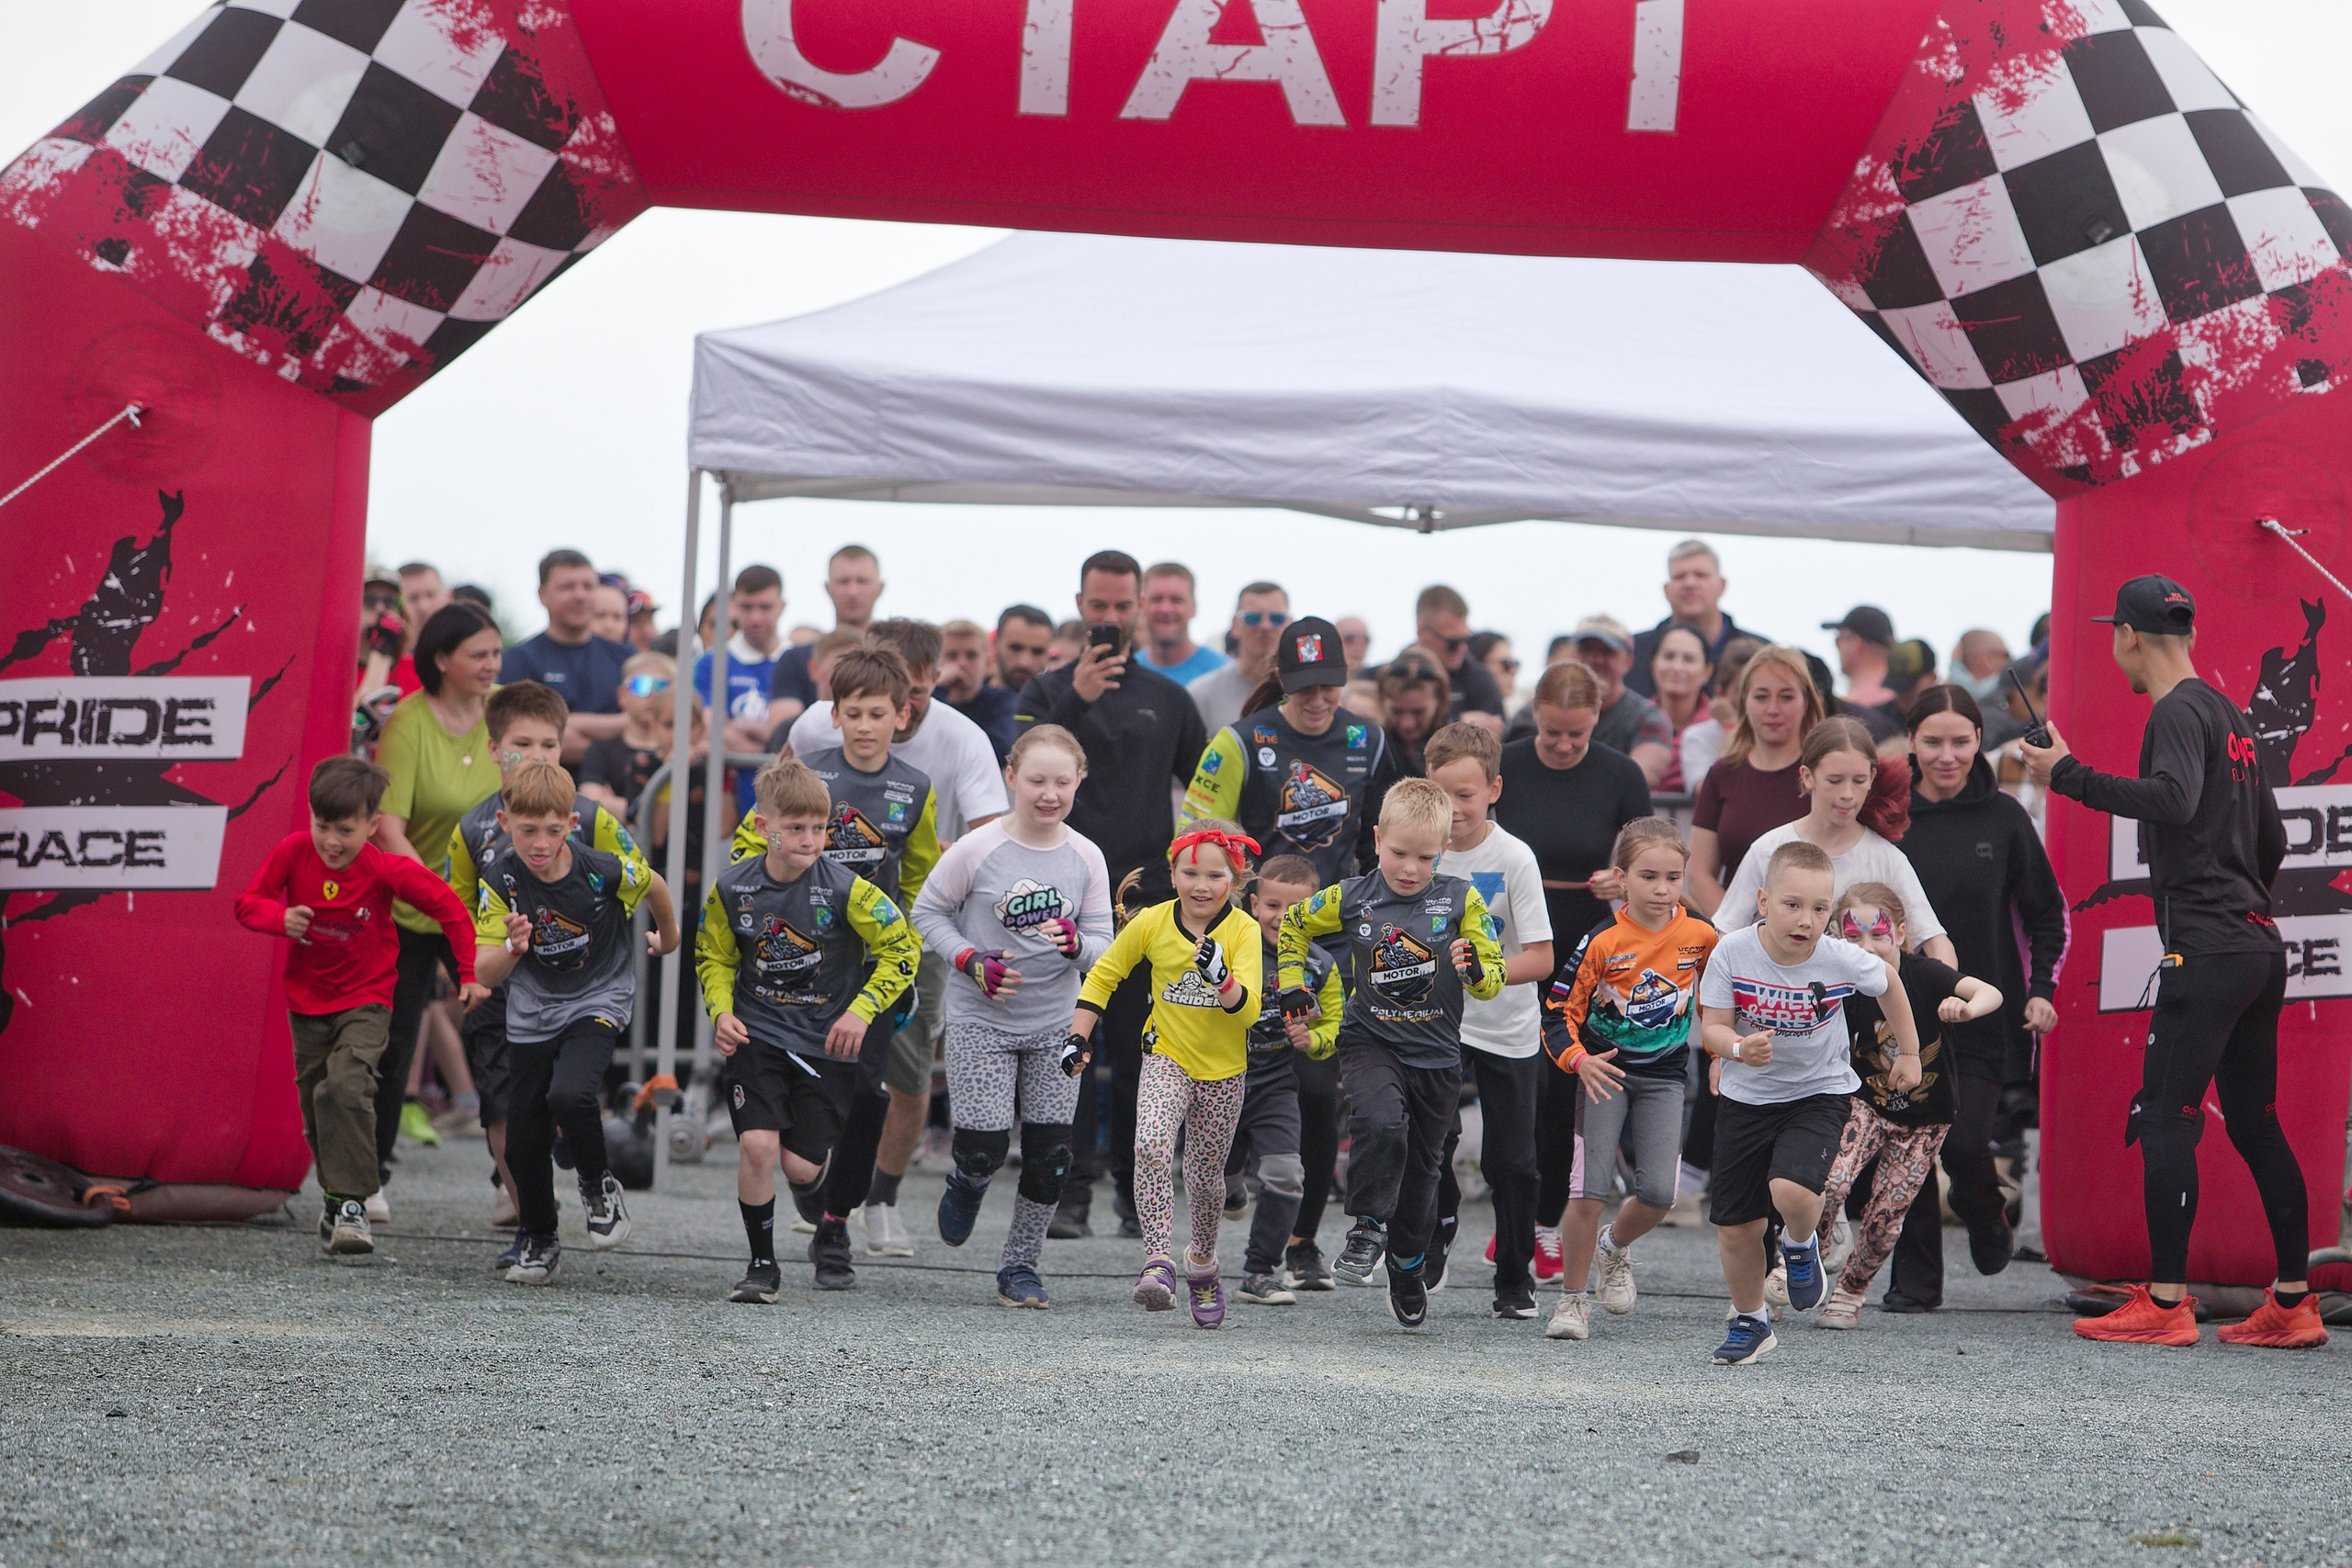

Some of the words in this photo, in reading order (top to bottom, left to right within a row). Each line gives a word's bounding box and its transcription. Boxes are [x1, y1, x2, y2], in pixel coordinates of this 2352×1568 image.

[1293, 807, 1330, 822] MOTOR
[0, 830, 166, 869] RACE
[829, 851, 867, 860] MOTOR
[1007, 888, 1061, 917] GIRL
[1005, 907, 1061, 927] POWER
[543, 940, 575, 953] MOTOR
[766, 959, 805, 971] MOTOR
[1383, 967, 1419, 981] MOTOR
[1638, 999, 1667, 1012] MOTOR
[1890, 1098, 1905, 1106] TO
